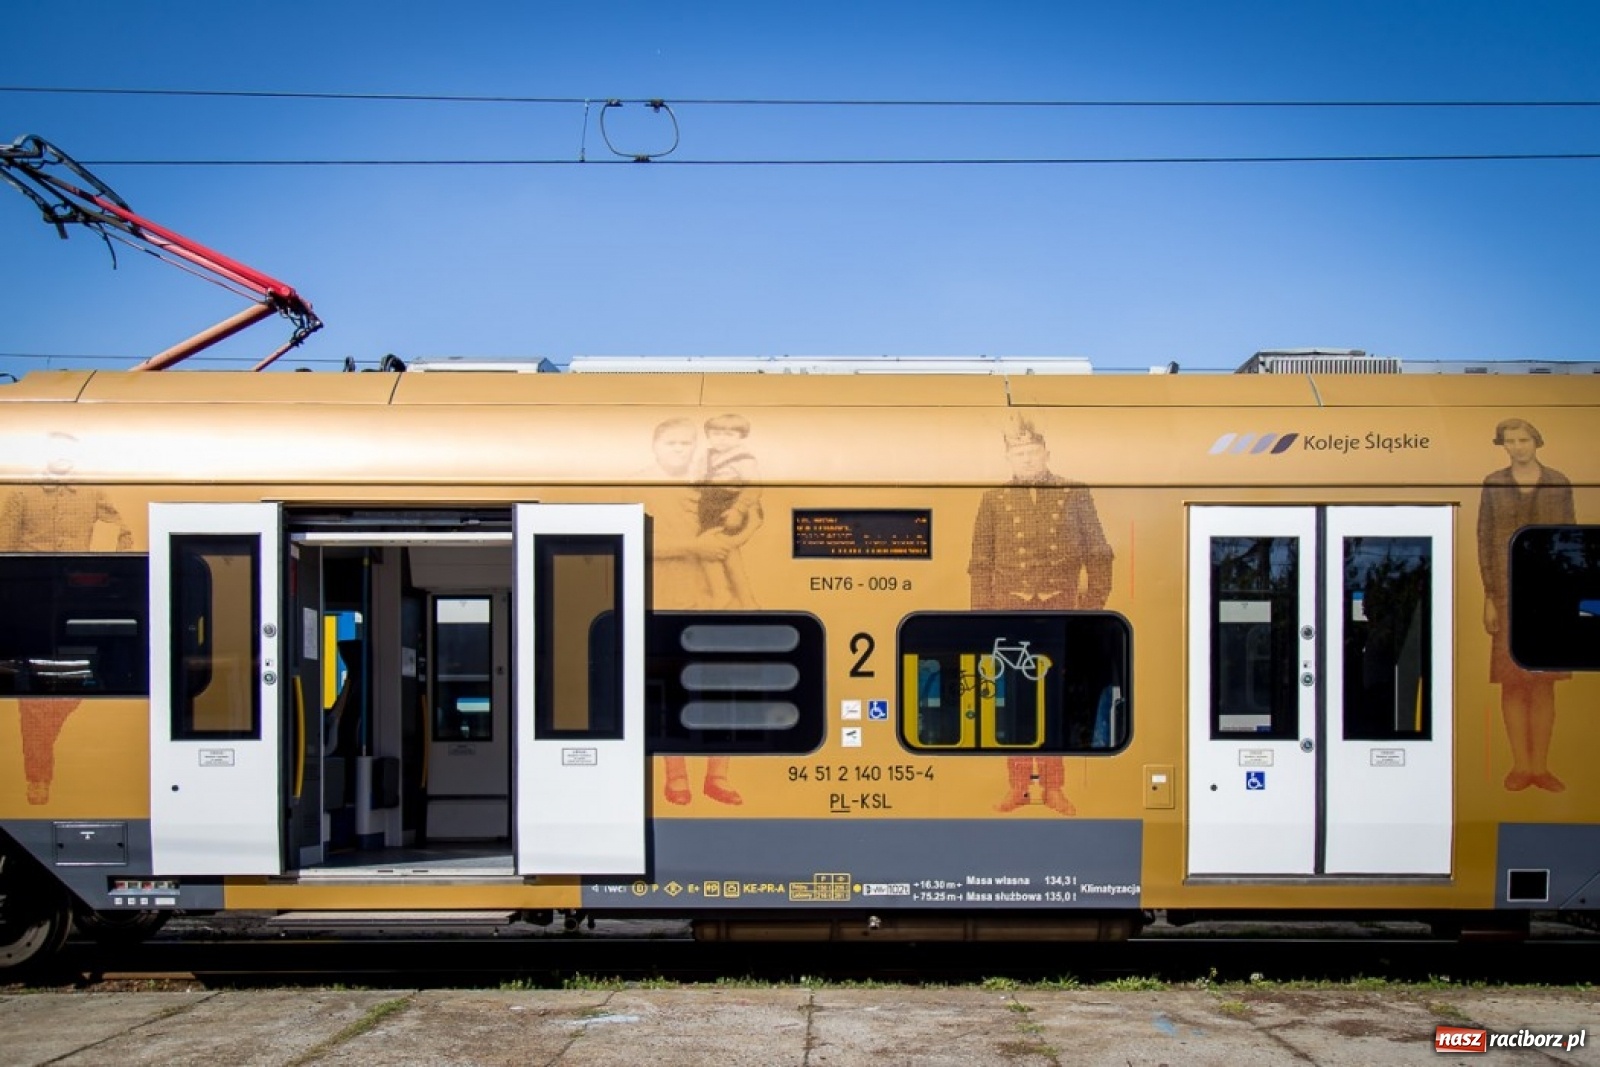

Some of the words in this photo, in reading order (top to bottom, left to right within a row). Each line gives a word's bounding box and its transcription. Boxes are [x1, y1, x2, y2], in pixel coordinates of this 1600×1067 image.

[1303, 435, 1360, 454] Koleje
[1364, 431, 1430, 454] Śląskie
[810, 577, 853, 591] EN76
[868, 577, 897, 591] 009
[902, 579, 912, 591] a
[849, 632, 875, 678] 2
[788, 766, 808, 781] 94
[815, 766, 831, 781] 51
[838, 766, 848, 781] 2
[855, 766, 881, 781] 140
[888, 765, 934, 781] 155-4
[829, 793, 892, 812] PL-KSL
[966, 875, 992, 885] Masa
[995, 875, 1030, 885] własna
[1044, 875, 1071, 886] 134,3
[743, 883, 786, 894] KE-PR-A
[1080, 884, 1141, 896] Klimatyzacja
[966, 891, 992, 902] Masa
[1044, 891, 1071, 903] 135,0
